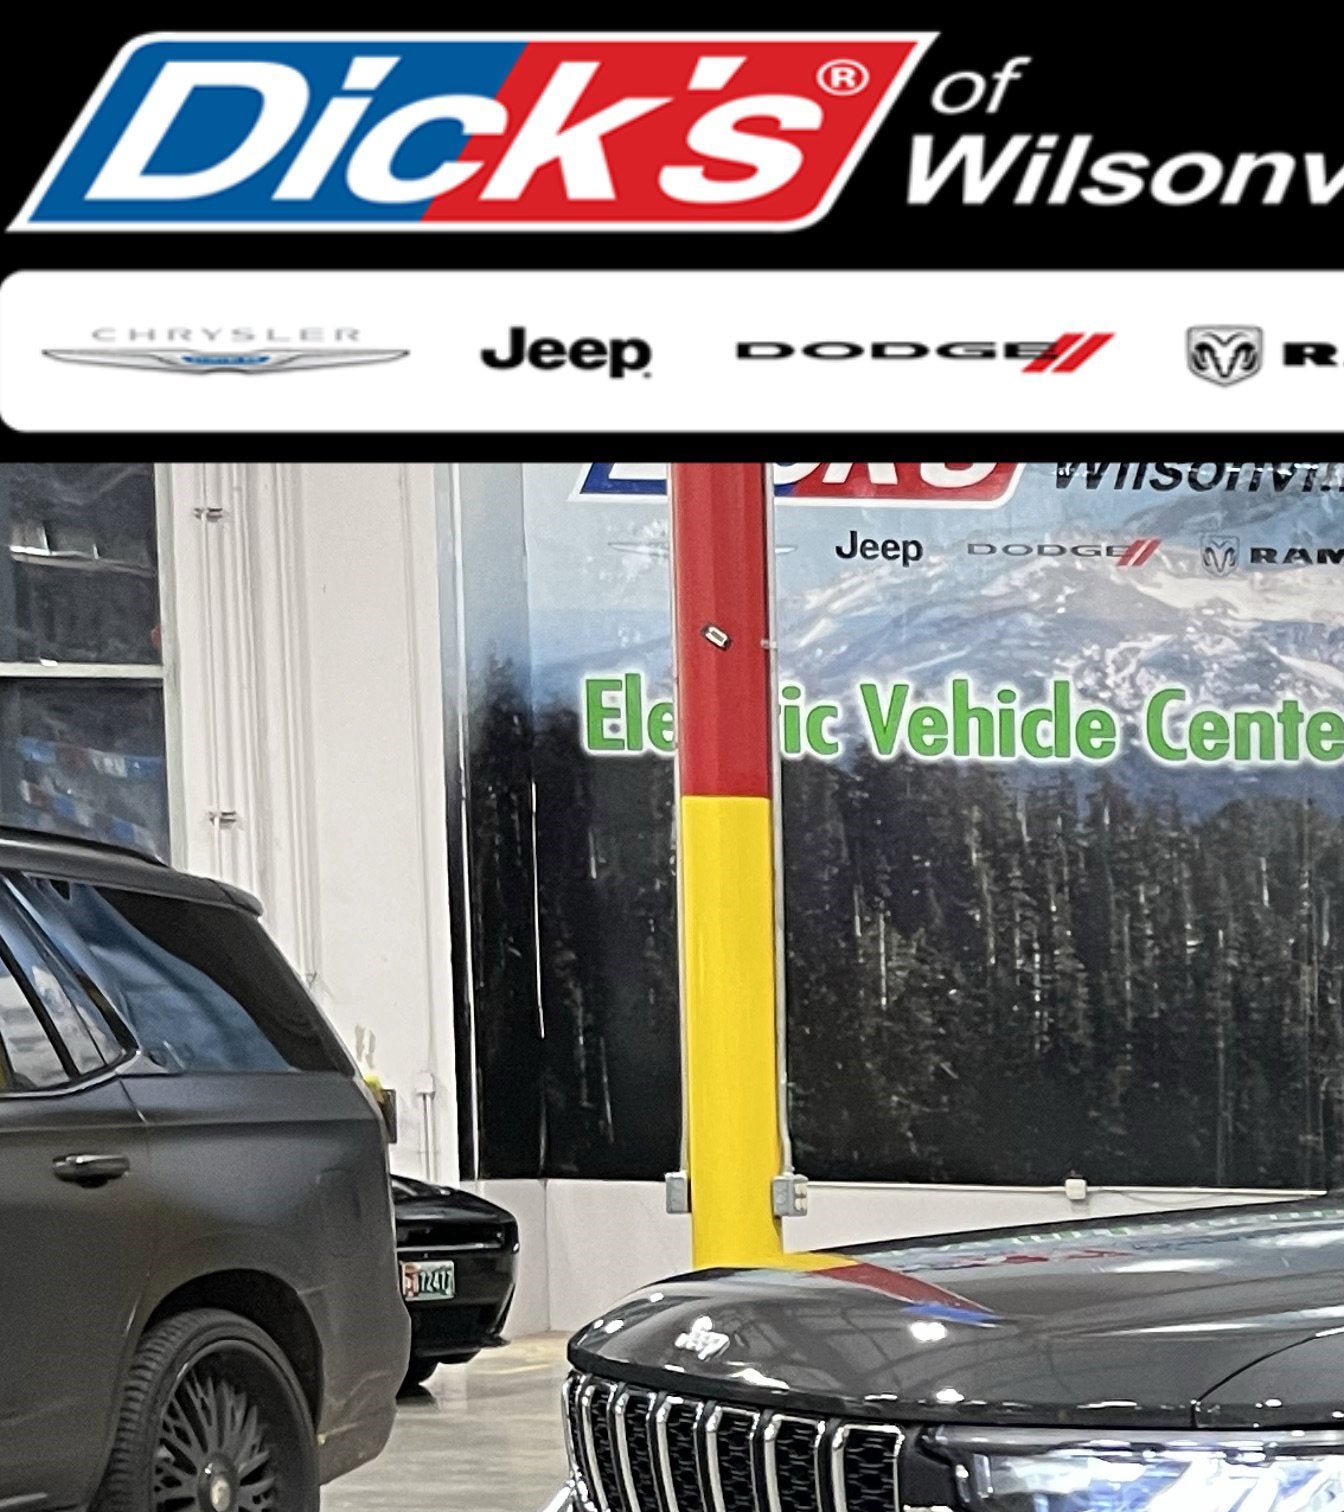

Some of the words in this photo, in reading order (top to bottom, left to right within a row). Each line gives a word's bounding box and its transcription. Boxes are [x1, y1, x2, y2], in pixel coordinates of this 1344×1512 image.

[835, 530, 924, 568] Jeep
[966, 543, 1132, 558] DODGE
[585, 672, 840, 757] Eleic
[859, 677, 1117, 760] Vehicle
